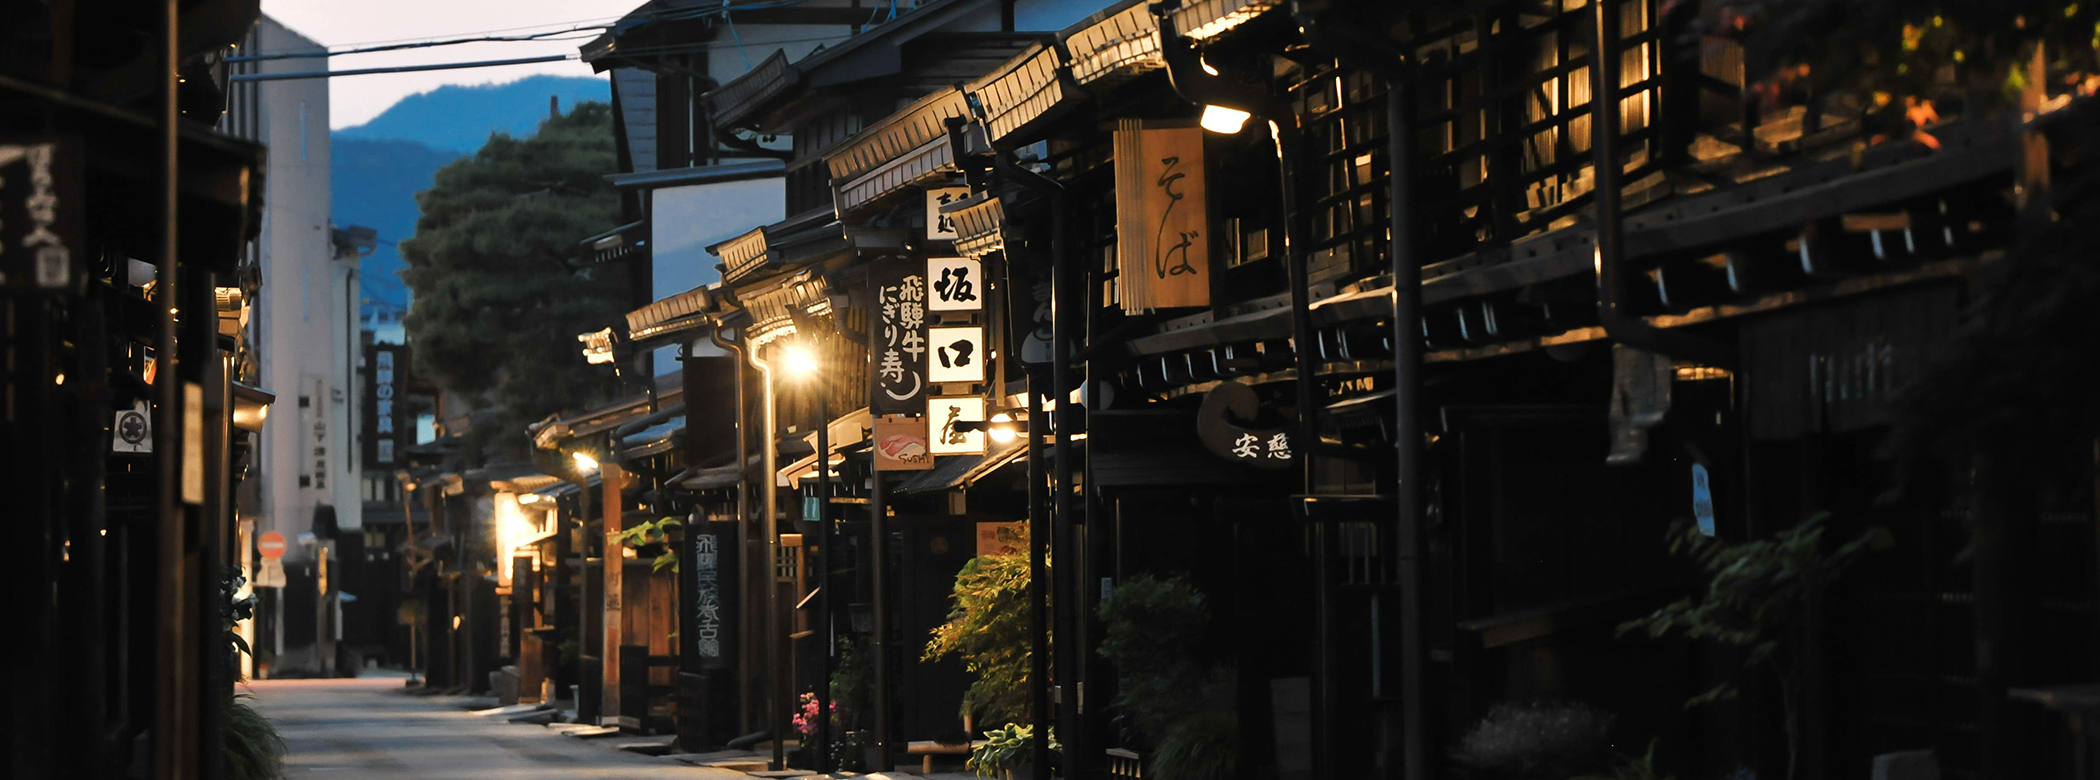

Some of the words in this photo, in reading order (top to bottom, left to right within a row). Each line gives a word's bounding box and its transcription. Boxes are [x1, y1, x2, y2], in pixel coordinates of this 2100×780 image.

[1155, 156, 1199, 279] そば
[900, 274, 925, 363] 飛騨牛
